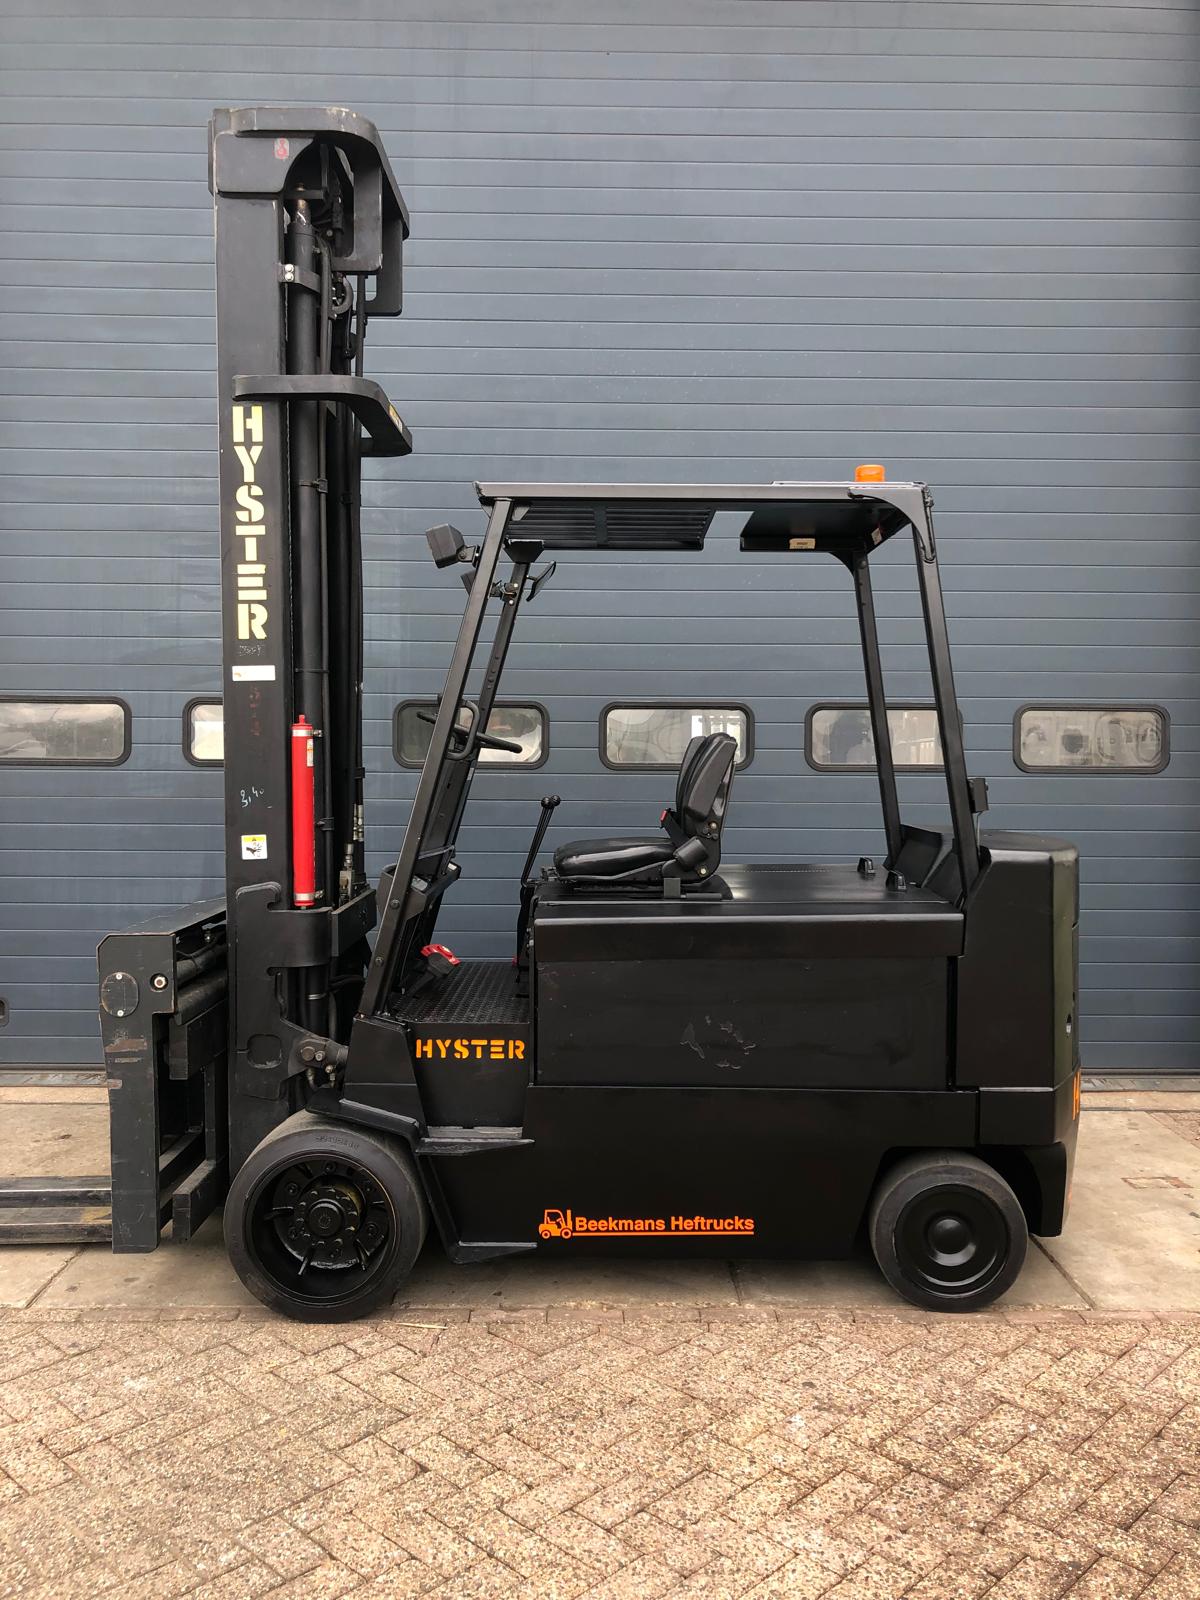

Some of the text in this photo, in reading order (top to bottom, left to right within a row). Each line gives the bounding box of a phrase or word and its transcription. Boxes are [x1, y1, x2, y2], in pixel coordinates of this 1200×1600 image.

[232, 405, 268, 640] HYSTER
[415, 1039, 525, 1059] HYSTER
[575, 1215, 755, 1231] Beekmans Heftrucks
